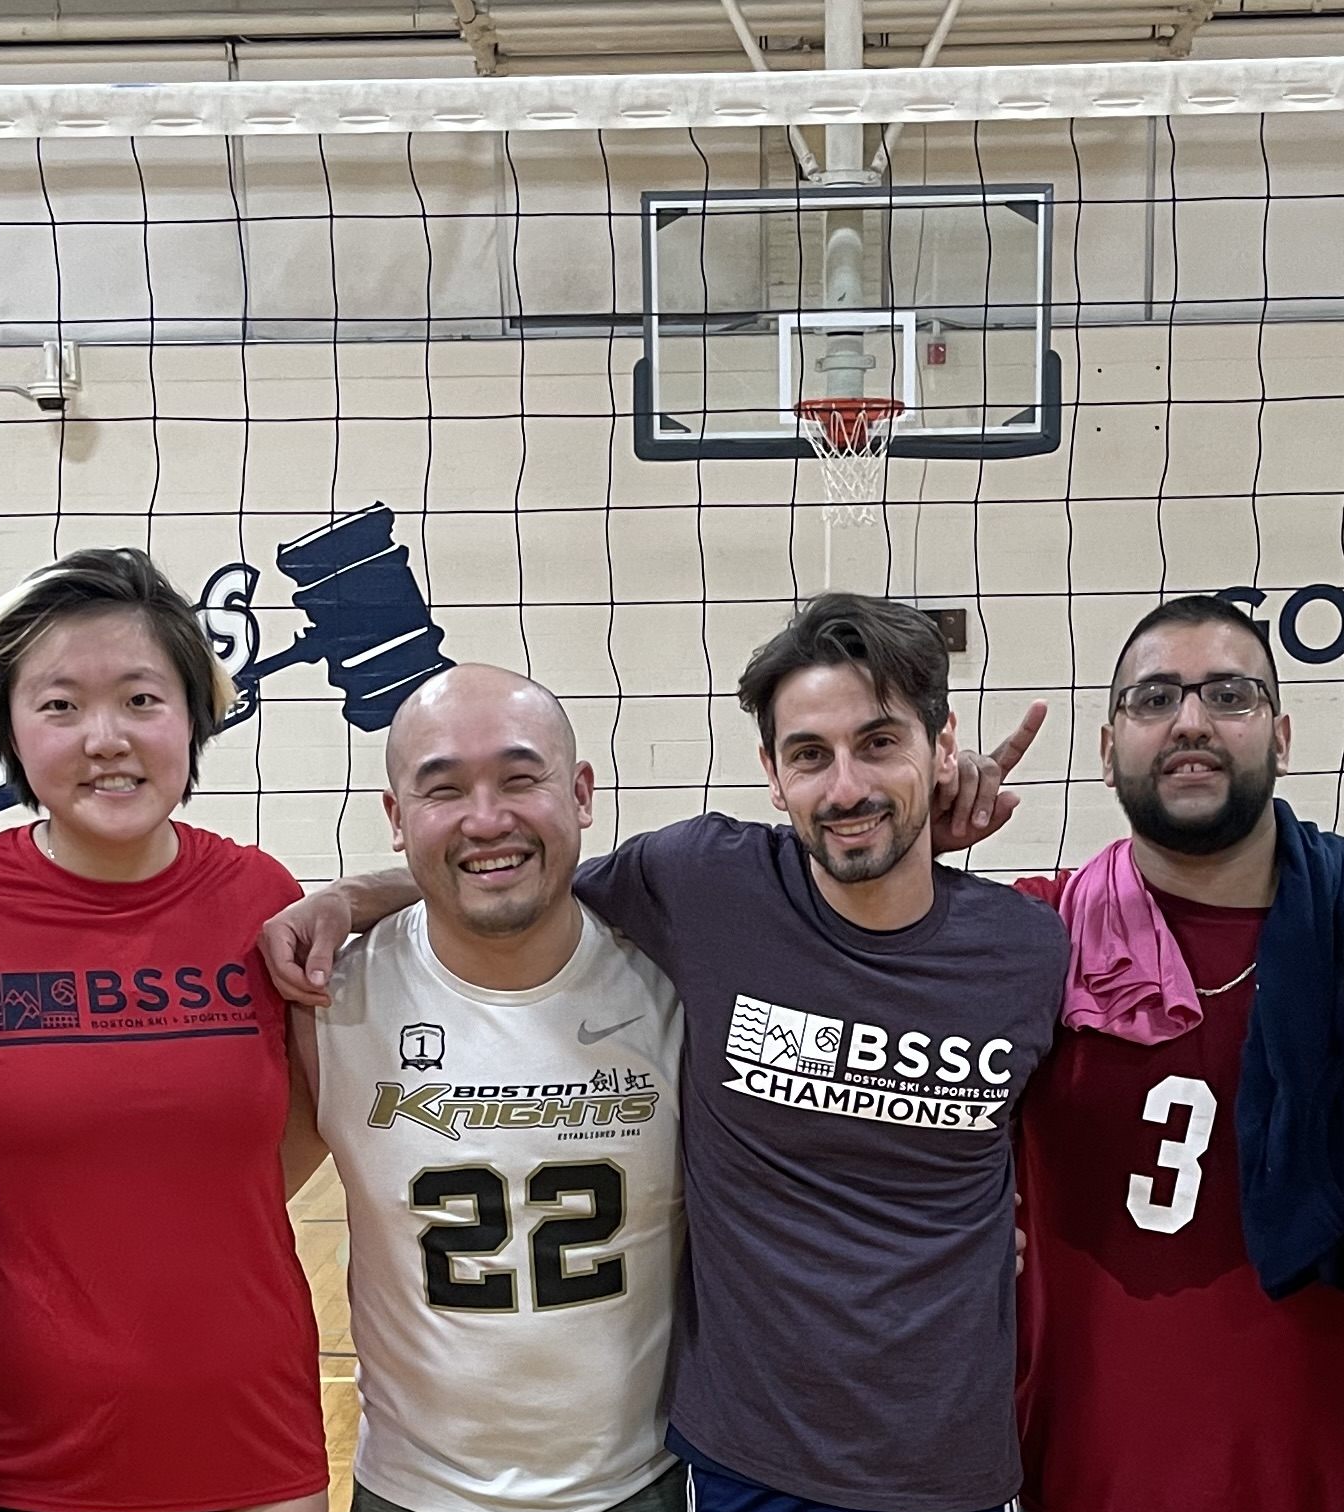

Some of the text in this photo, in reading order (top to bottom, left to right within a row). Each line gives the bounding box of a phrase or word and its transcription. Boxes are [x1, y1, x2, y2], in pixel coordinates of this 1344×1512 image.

[86, 963, 253, 1014] BSSC
[91, 1018, 144, 1029] BOSTON
[183, 1014, 228, 1025] SPORTS
[415, 1035, 428, 1058] 1
[847, 1023, 1013, 1084] BSSC
[367, 1082, 659, 1141] KNIGHTS
[453, 1083, 588, 1098] BOSTON
[745, 1069, 962, 1126] CHAMPIONS
[844, 1073, 896, 1089] BOSTON
[899, 1081, 920, 1093] SKI
[934, 1085, 980, 1099] SPORTS
[982, 1088, 1010, 1099] CLUB
[557, 1130, 616, 1141] ESTABLISHED
[1126, 1075, 1217, 1235] 3
[408, 1157, 628, 1313] 22
